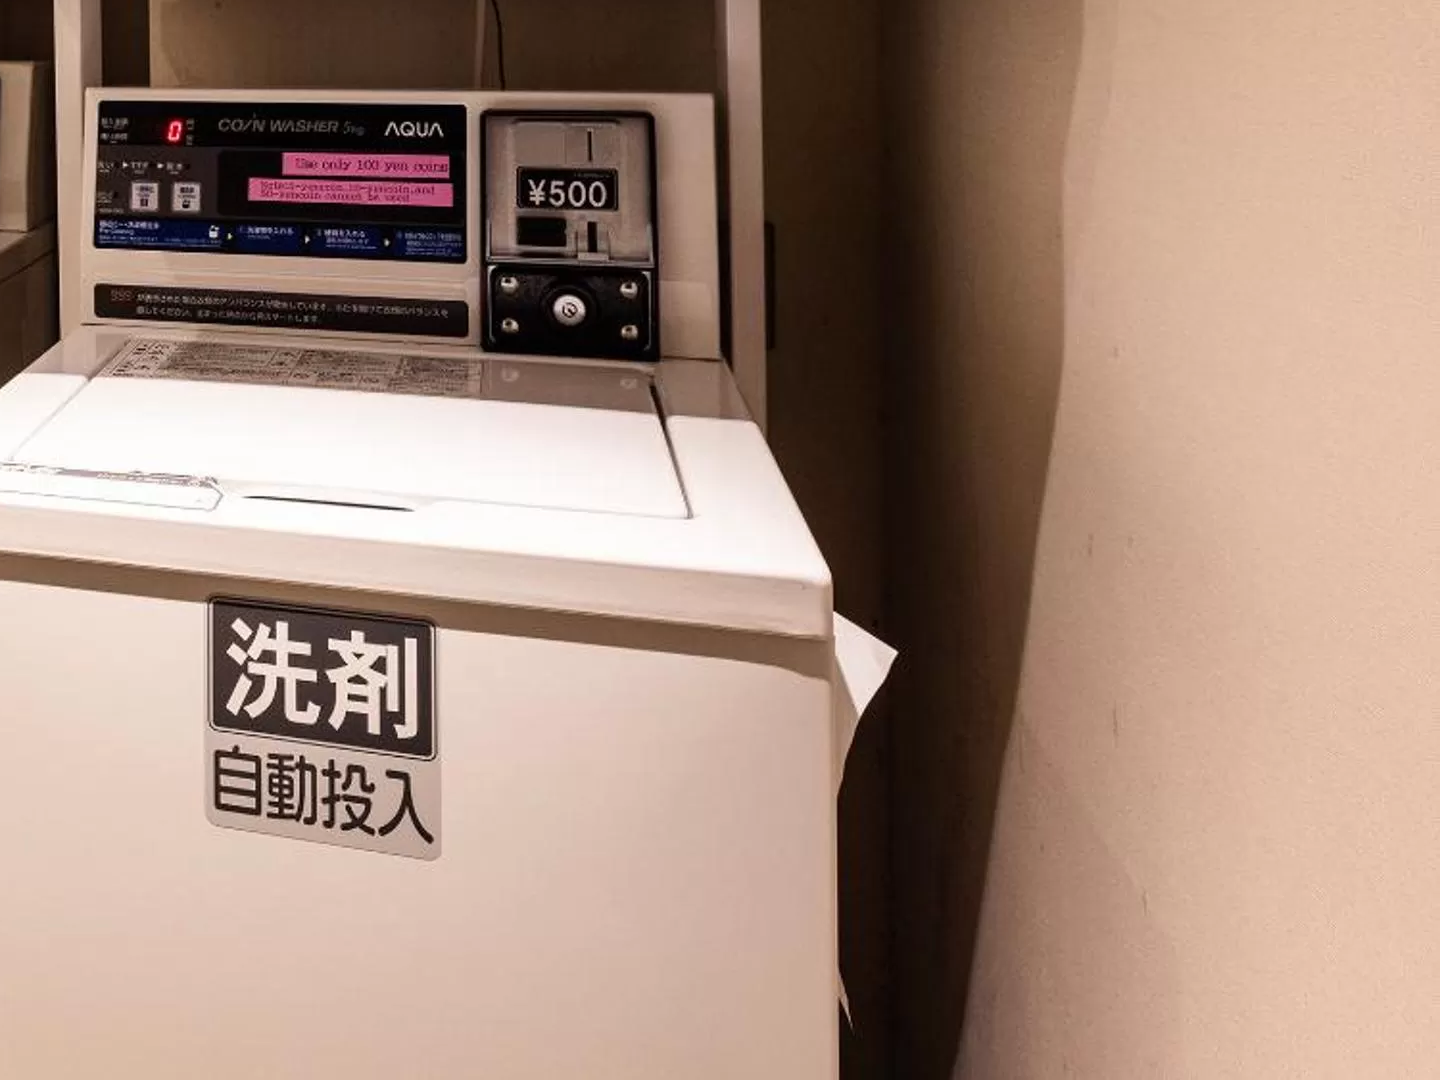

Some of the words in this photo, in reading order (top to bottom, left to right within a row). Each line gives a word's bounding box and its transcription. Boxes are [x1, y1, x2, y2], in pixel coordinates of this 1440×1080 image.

[168, 120, 182, 142] 0
[270, 119, 339, 133] WASHER
[384, 121, 444, 138] AQUA
[321, 158, 351, 171] only
[528, 179, 607, 208] ¥500
[225, 617, 418, 740] 洗剤
[214, 745, 435, 845] 自動投入
